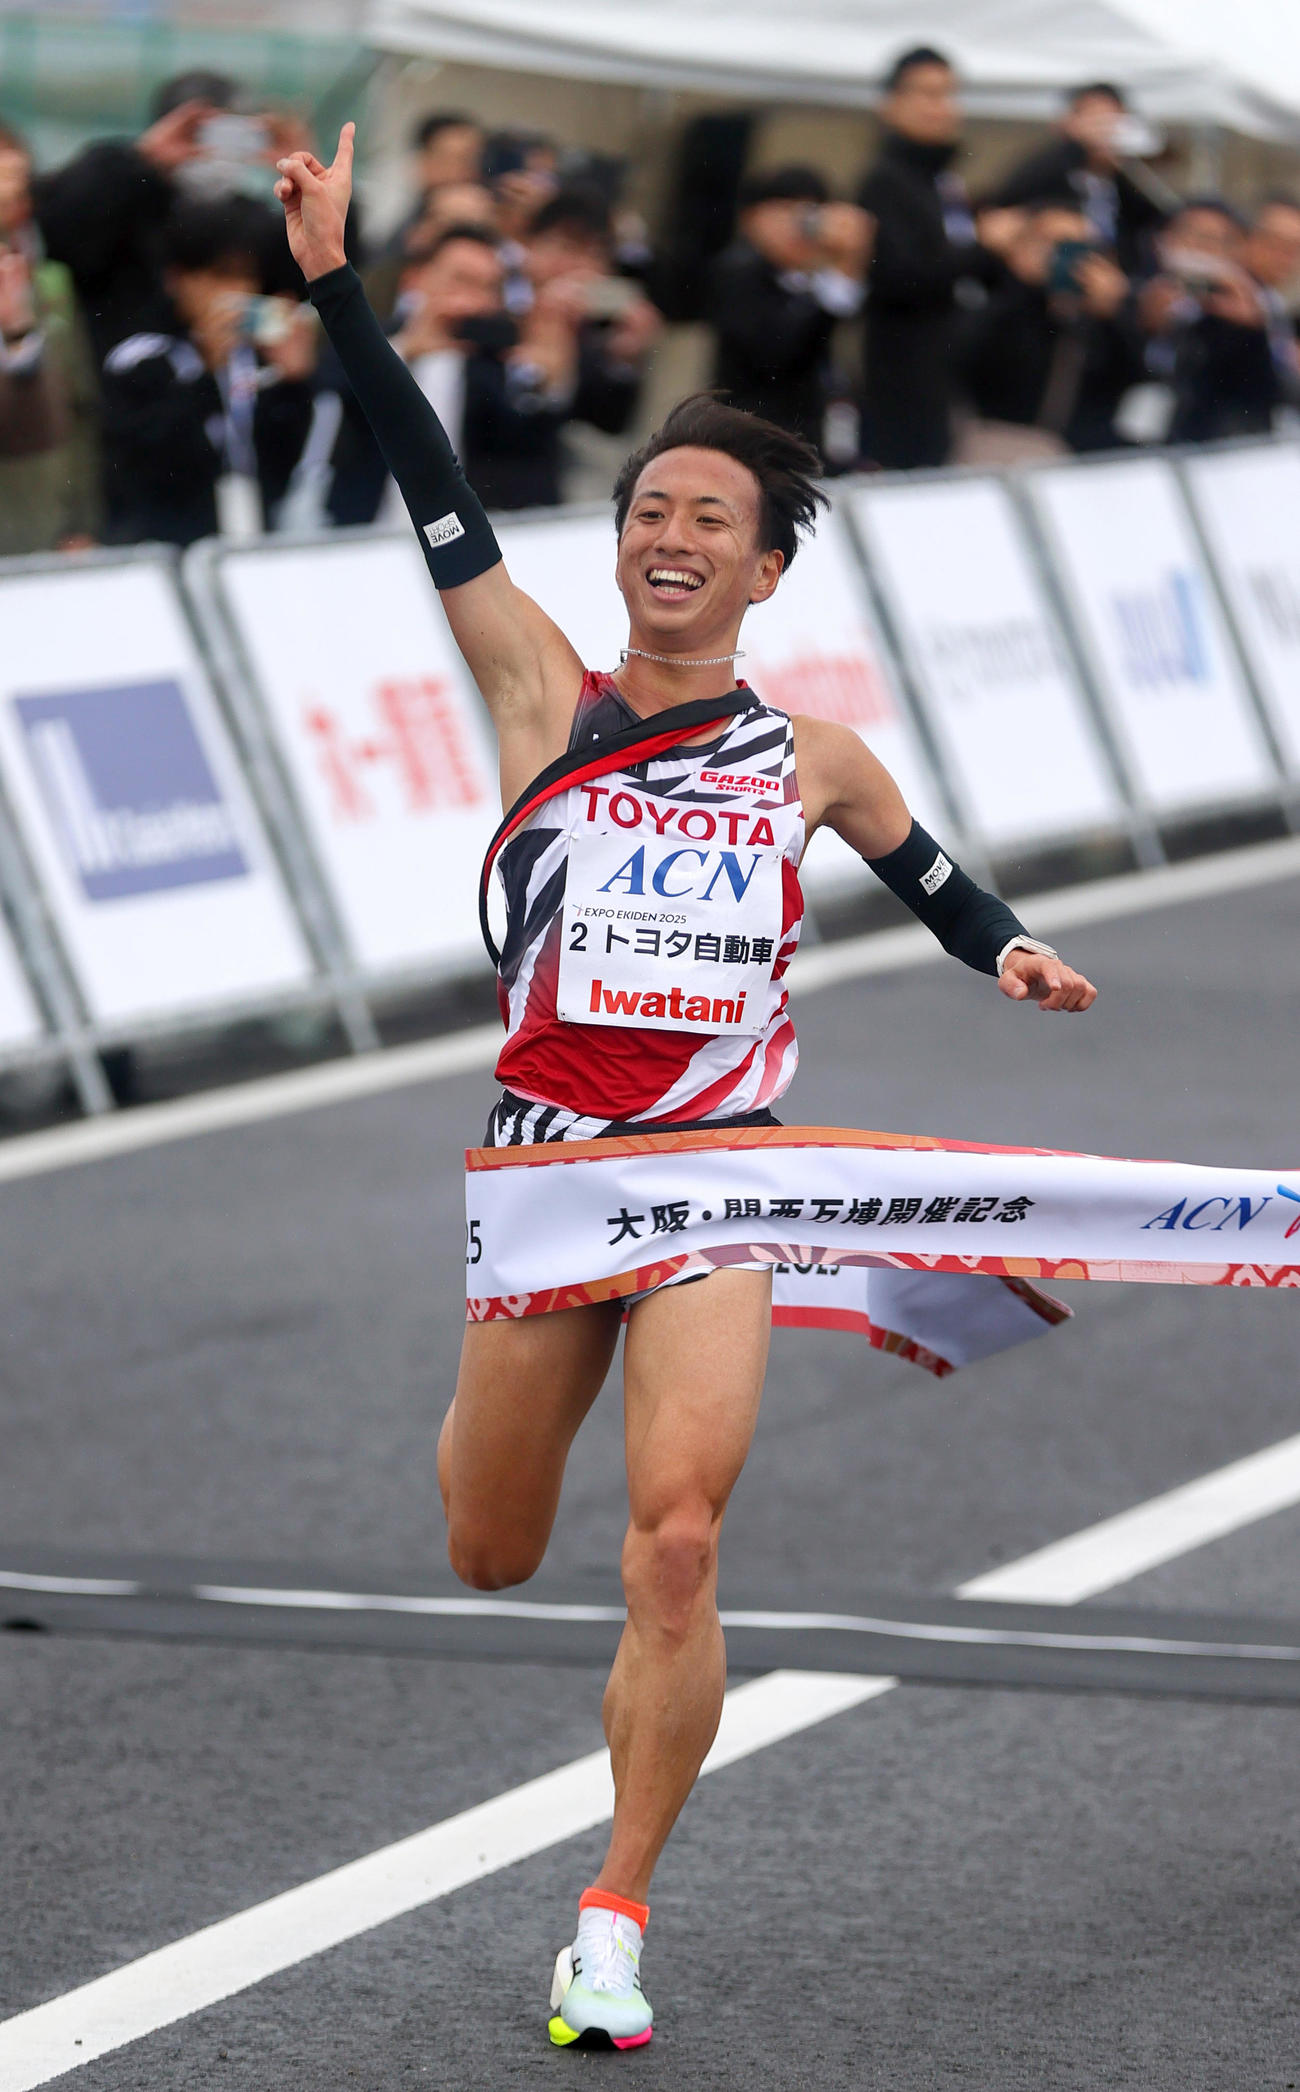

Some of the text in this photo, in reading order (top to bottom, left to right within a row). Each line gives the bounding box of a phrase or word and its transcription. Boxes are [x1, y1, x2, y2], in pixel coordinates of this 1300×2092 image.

[430, 524, 460, 544] MOVE
[700, 771, 780, 791] GAZOO
[715, 783, 766, 796] SPORTS
[580, 785, 775, 846] TOYOTA
[596, 844, 763, 903] ACN
[924, 859, 945, 885] MOVE
[584, 907, 687, 924] EXPO EKIDEN 2025
[569, 921, 775, 966] 2 トヨタ自動車
[589, 979, 747, 1024] Iwatani
[1139, 1196, 1273, 1231] ACN
[466, 1220, 482, 1264] 5
